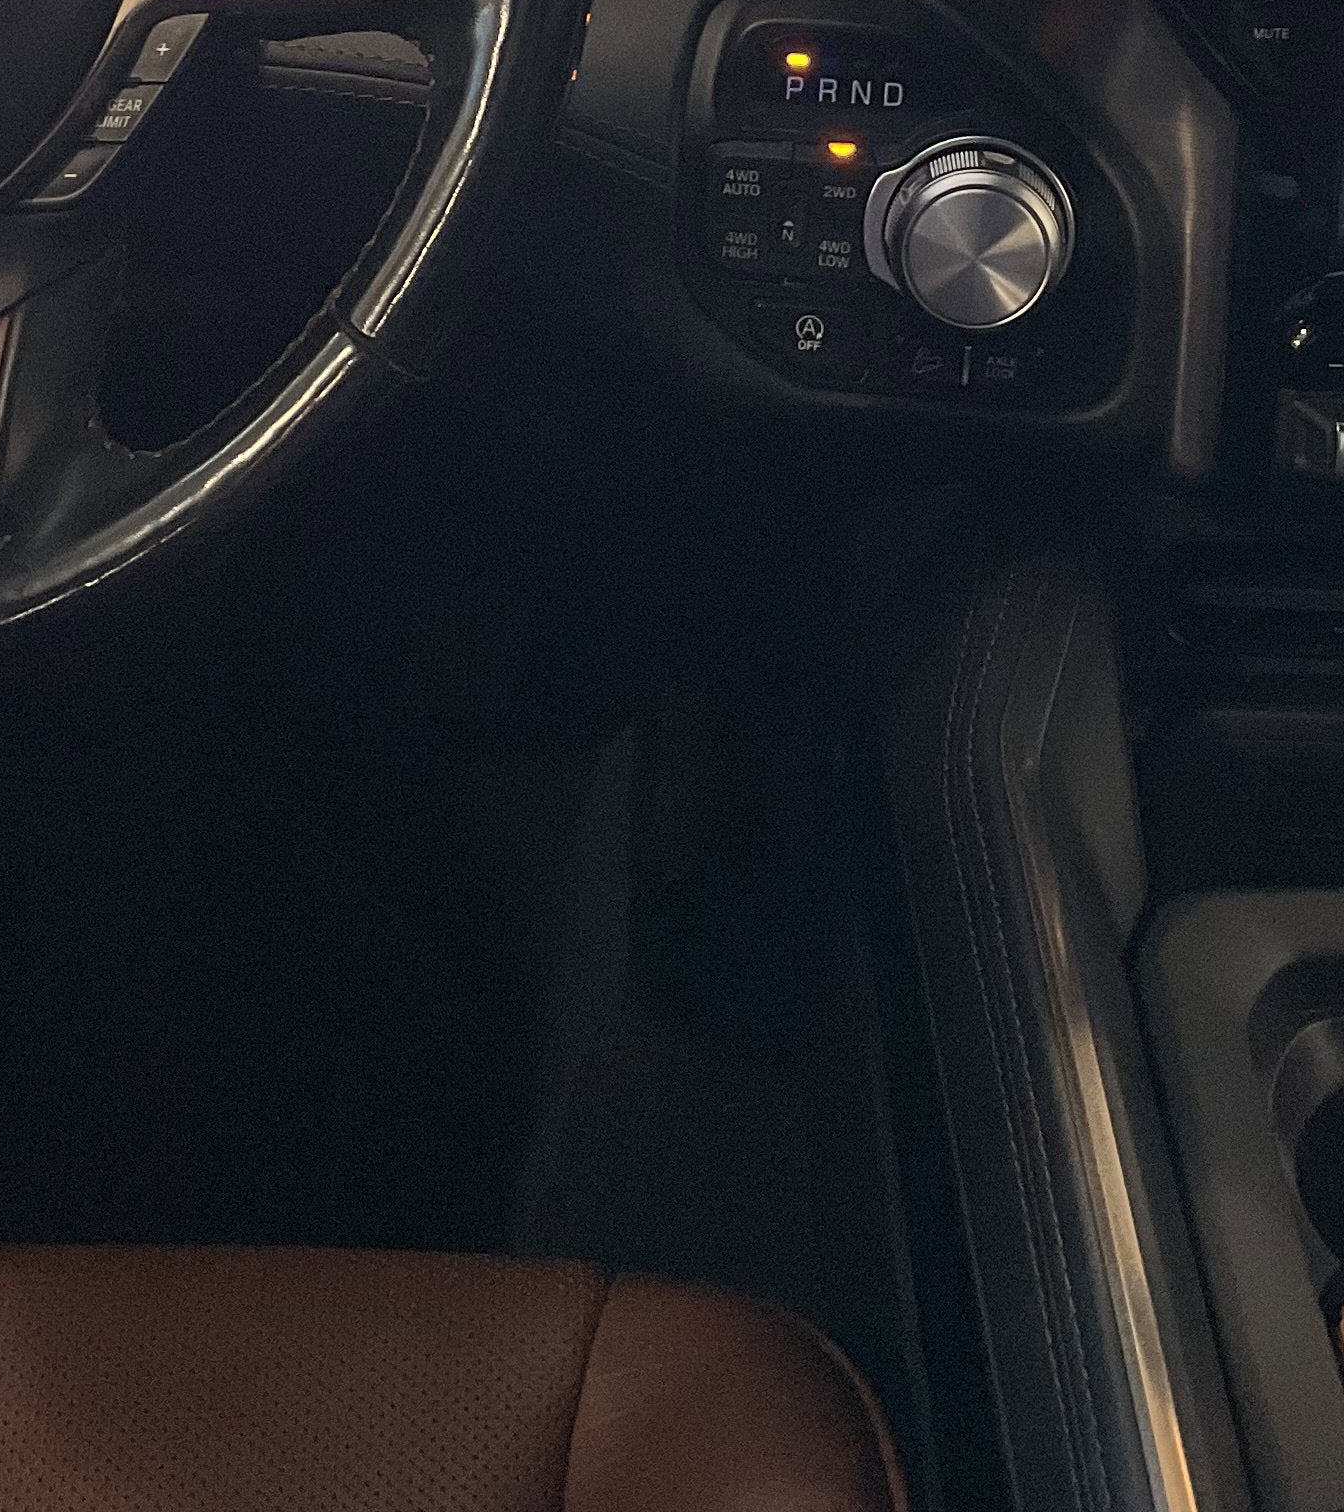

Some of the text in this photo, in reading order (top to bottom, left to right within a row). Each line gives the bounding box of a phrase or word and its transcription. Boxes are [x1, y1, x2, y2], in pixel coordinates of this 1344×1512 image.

[1254, 28, 1289, 39] MUTE
[785, 76, 904, 107] P R N D
[108, 99, 143, 112] GEAR
[725, 169, 759, 182] 4WD
[723, 184, 761, 196] AUTO
[823, 185, 856, 199] 2WD
[725, 231, 758, 245] 4WD
[782, 229, 795, 241] N
[722, 245, 758, 258] HIGH
[818, 240, 851, 254] 4WD
[818, 254, 850, 268] LOW
[797, 340, 822, 351] OFF
